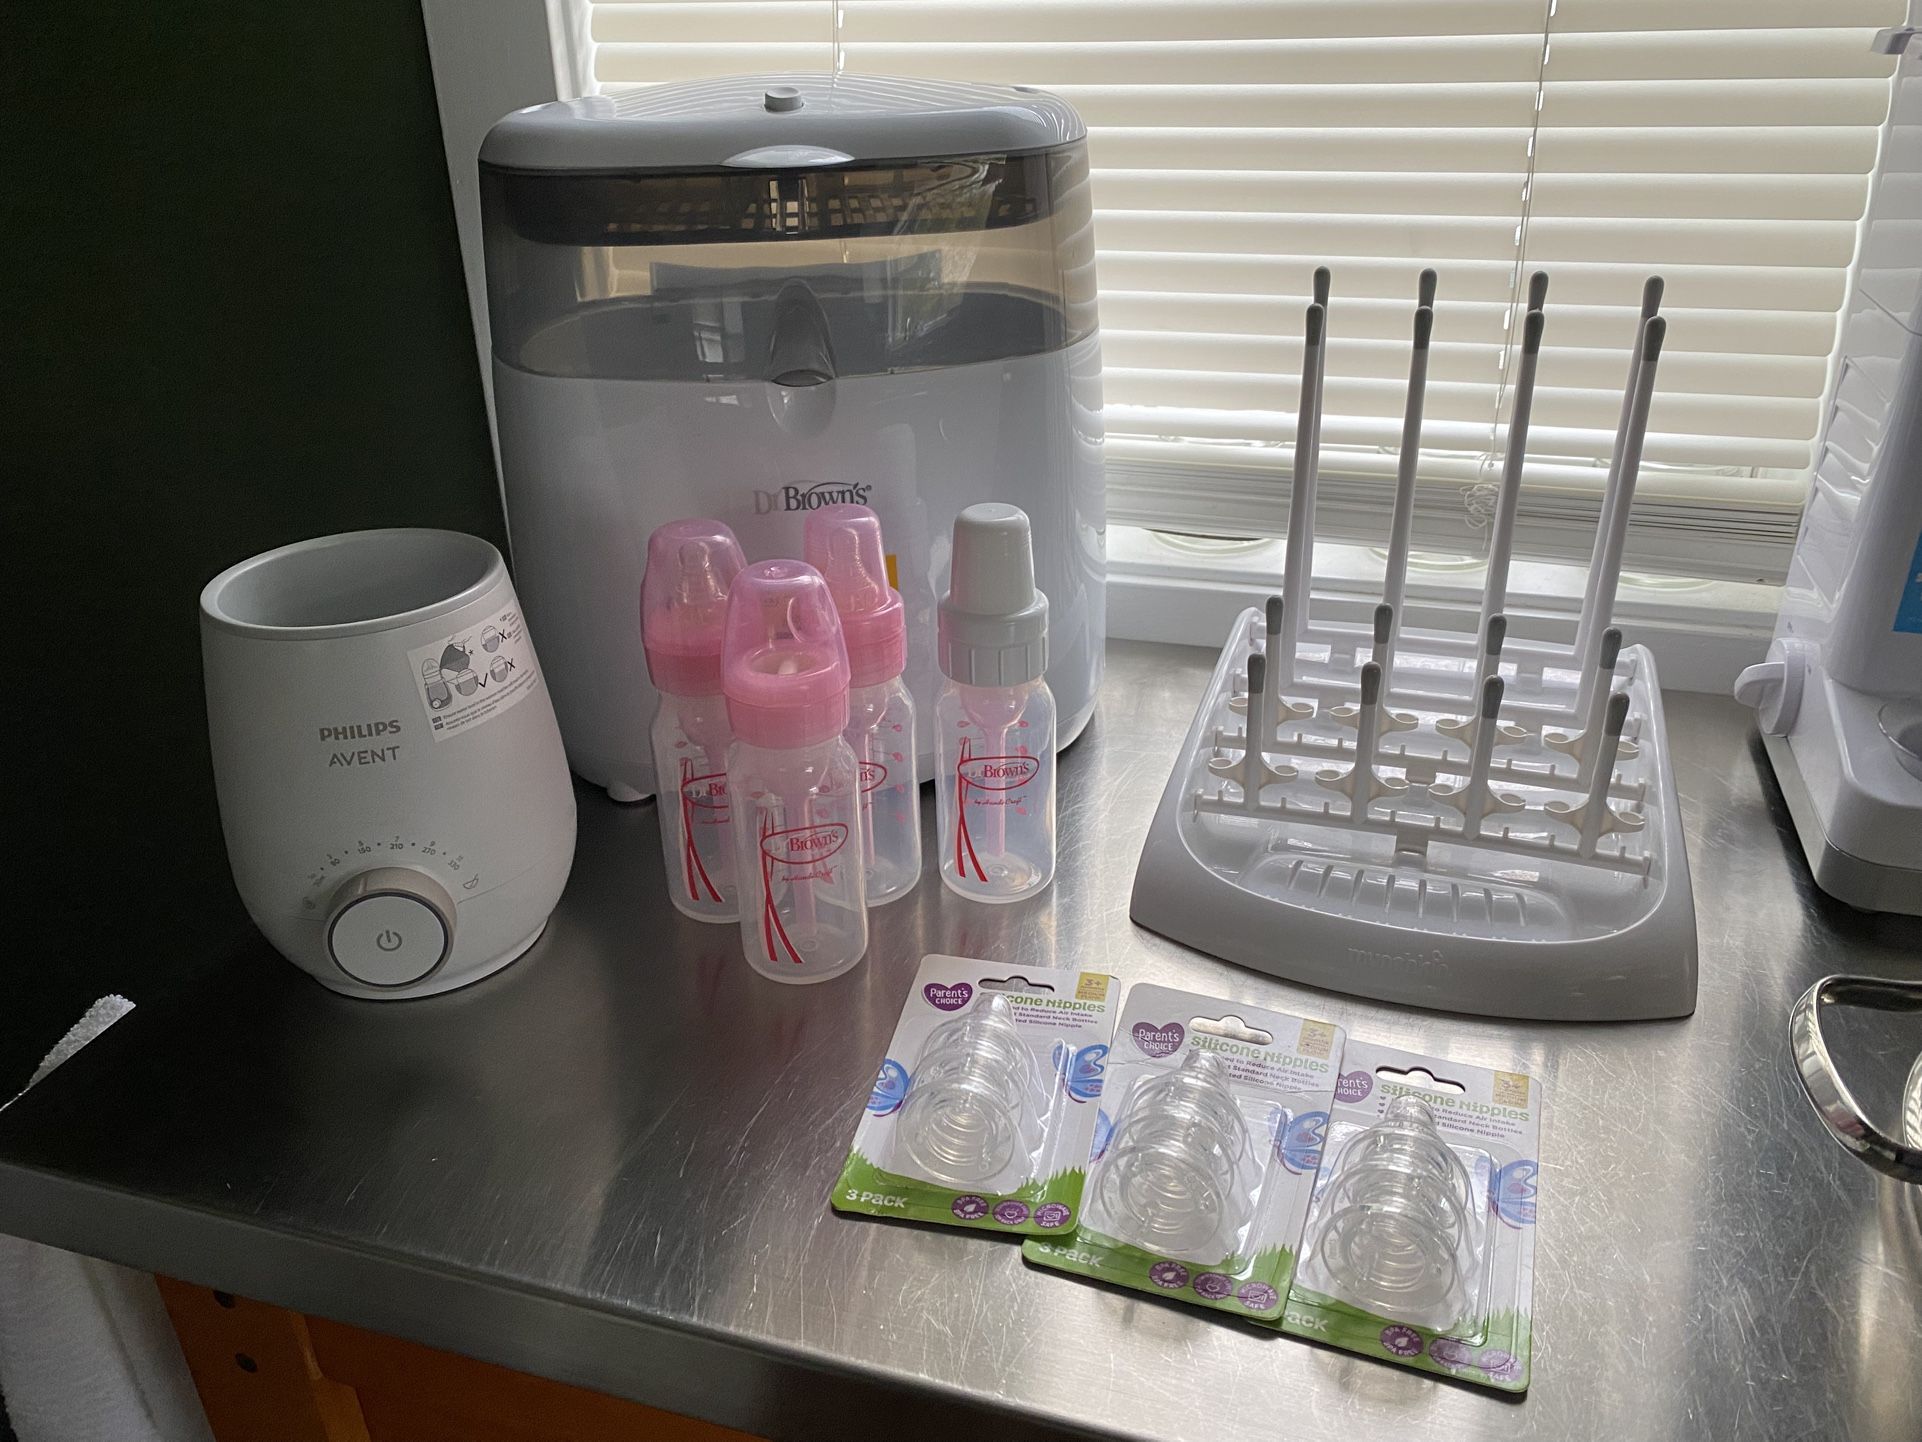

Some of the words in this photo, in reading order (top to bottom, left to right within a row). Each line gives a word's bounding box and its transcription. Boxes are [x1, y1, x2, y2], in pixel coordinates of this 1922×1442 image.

[782, 481, 868, 511] Brown's
[319, 720, 401, 741] PHILIPS
[329, 746, 401, 767] AVENT
[984, 762, 1030, 778] Brown's
[930, 987, 968, 998] Parent's
[935, 997, 963, 1005] CHOICE
[1046, 999, 1106, 1013] Nipples
[1139, 1028, 1180, 1042] Parent's
[1143, 1042, 1173, 1051] CHOICE
[1263, 1051, 1329, 1074] Nipples
[1337, 1077, 1368, 1089] rent's
[1337, 1087, 1363, 1096] HOICE
[1459, 1100, 1530, 1122] Nipples
[846, 1189, 858, 1200] 3
[1285, 1310, 1329, 1333] ack
